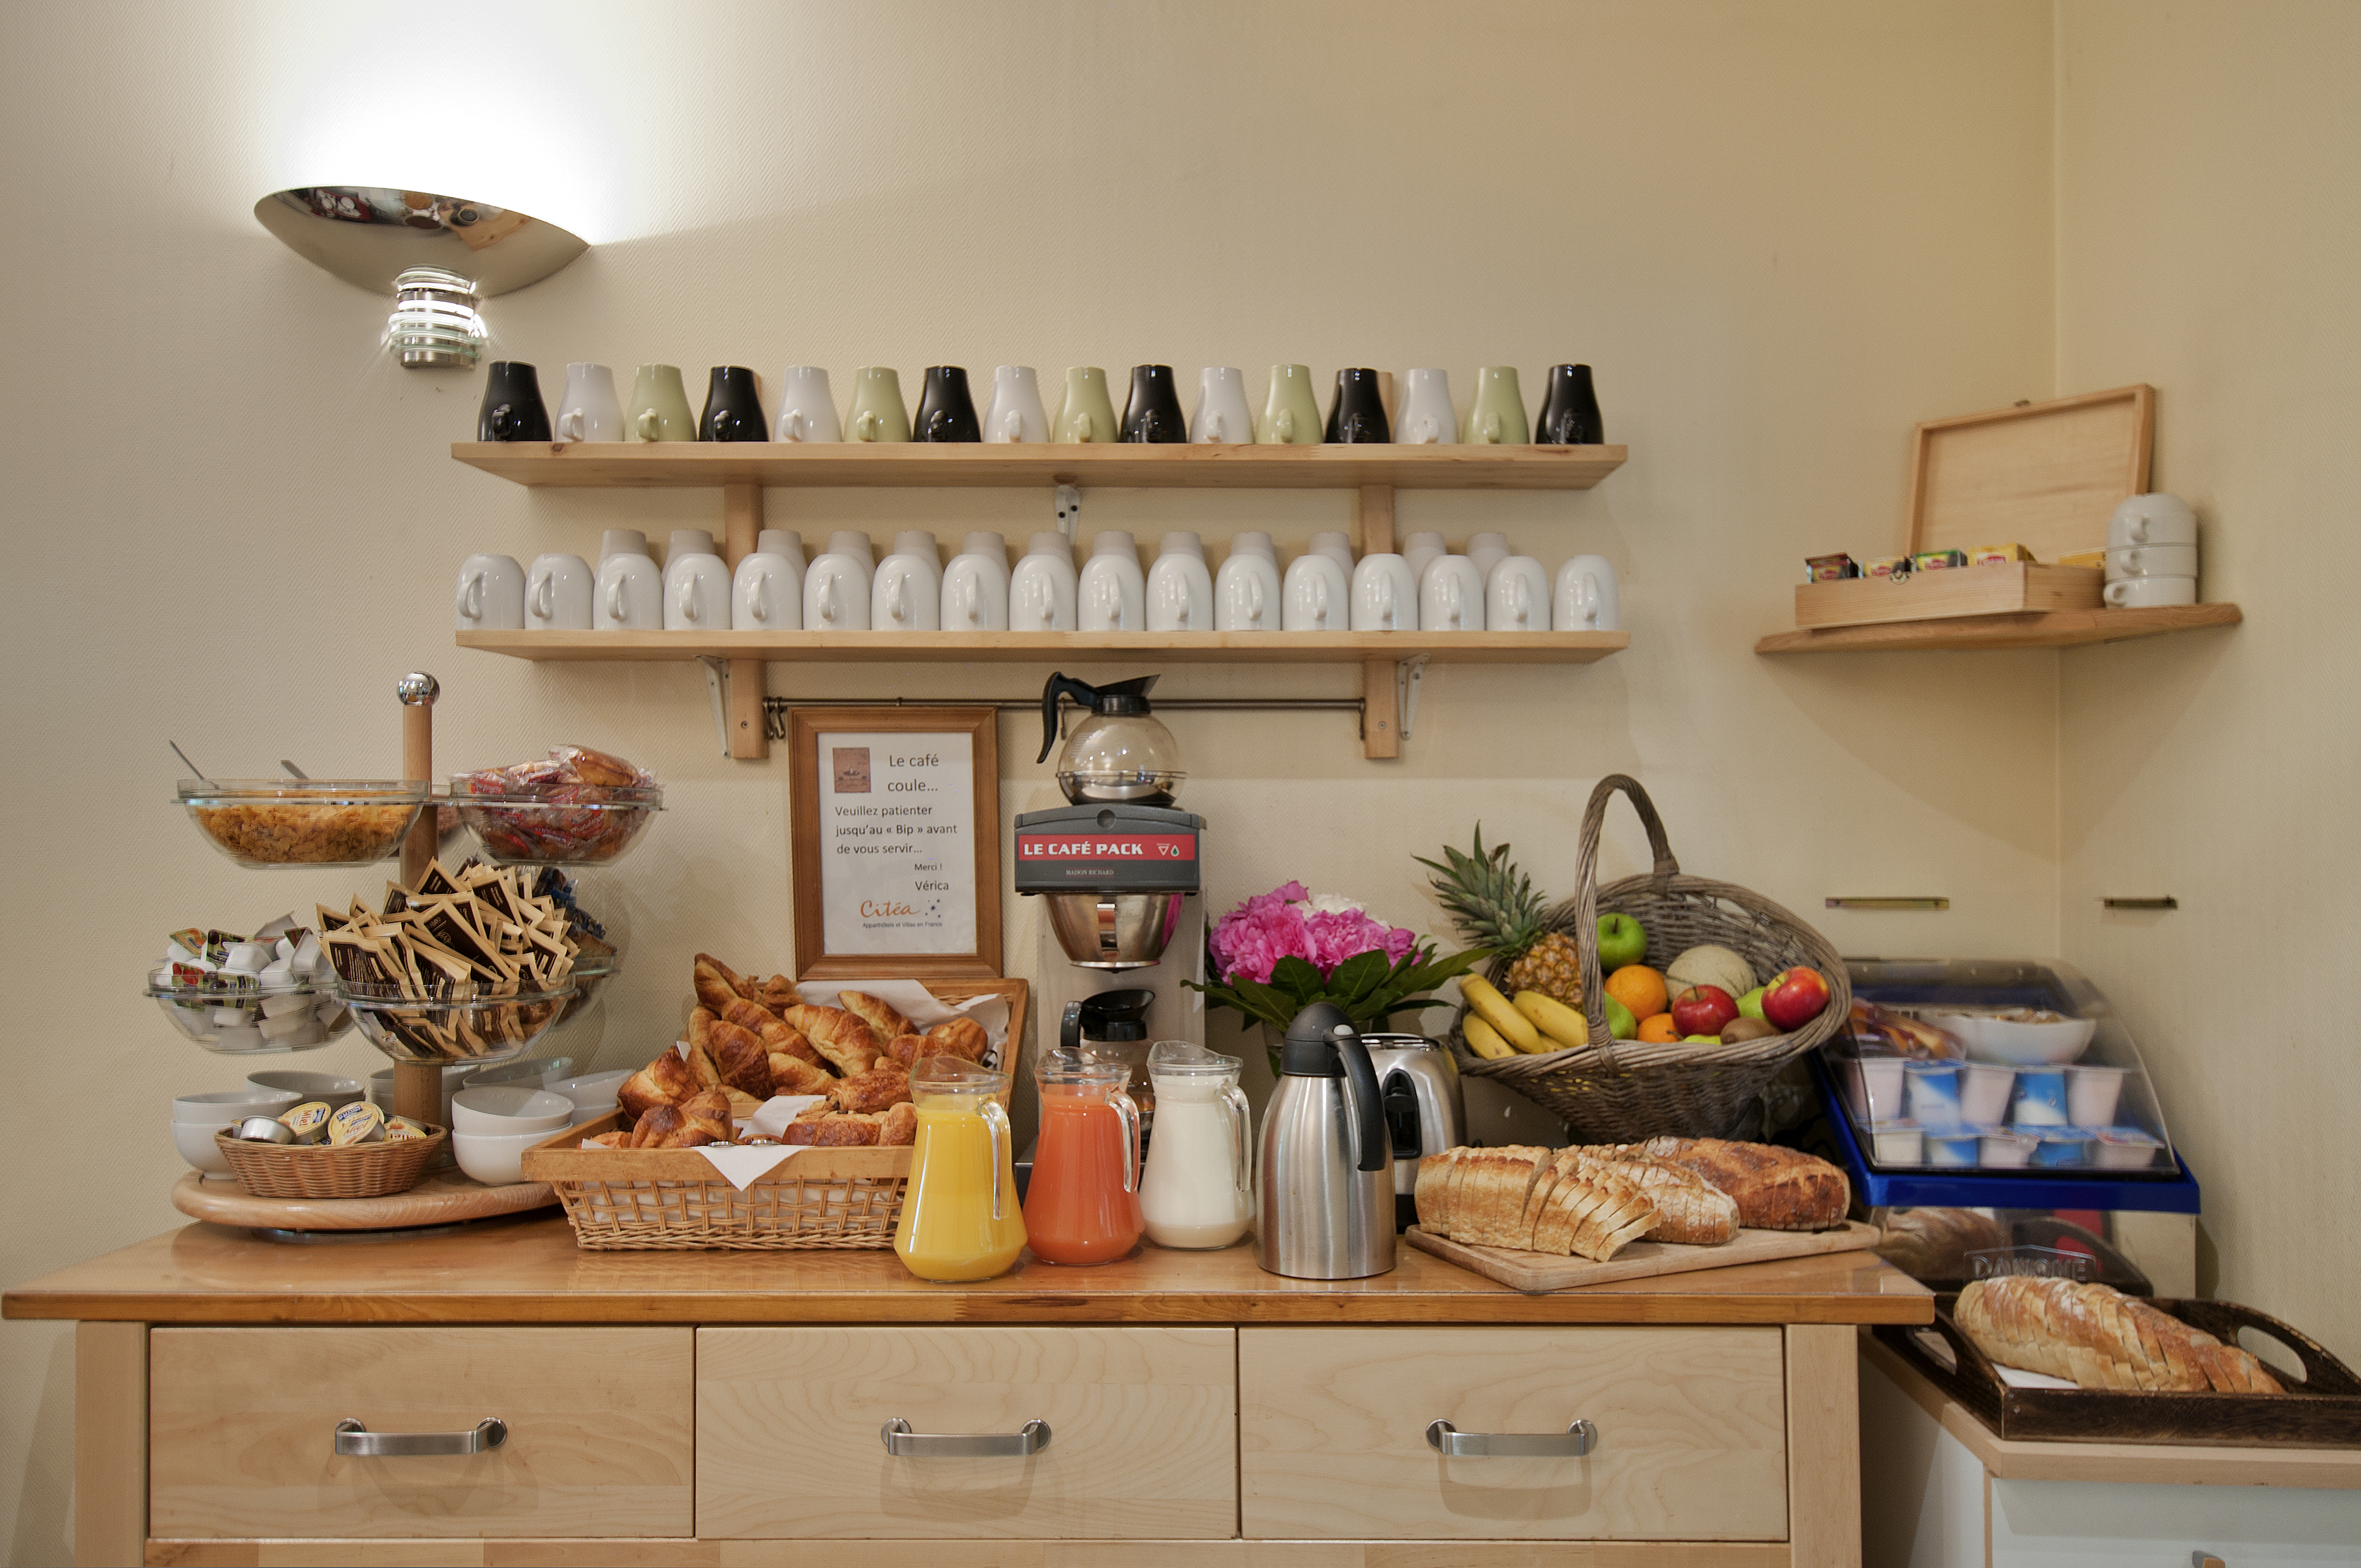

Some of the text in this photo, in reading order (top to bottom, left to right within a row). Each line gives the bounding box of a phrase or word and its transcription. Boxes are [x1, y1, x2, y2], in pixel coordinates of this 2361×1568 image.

[889, 753, 939, 767] Le café
[888, 779, 938, 792] coule...
[835, 806, 933, 818] Veuillez patienter
[896, 824, 914, 836] Bip
[926, 824, 957, 834] avant
[836, 843, 923, 854] de vous servir...
[1024, 841, 1143, 855] LE CAFÉ PACK
[914, 879, 949, 891] Vérica
[860, 899, 920, 918] Citéa
[299, 1109, 312, 1126] Miel
[1973, 1256, 2086, 1281] DANONE
